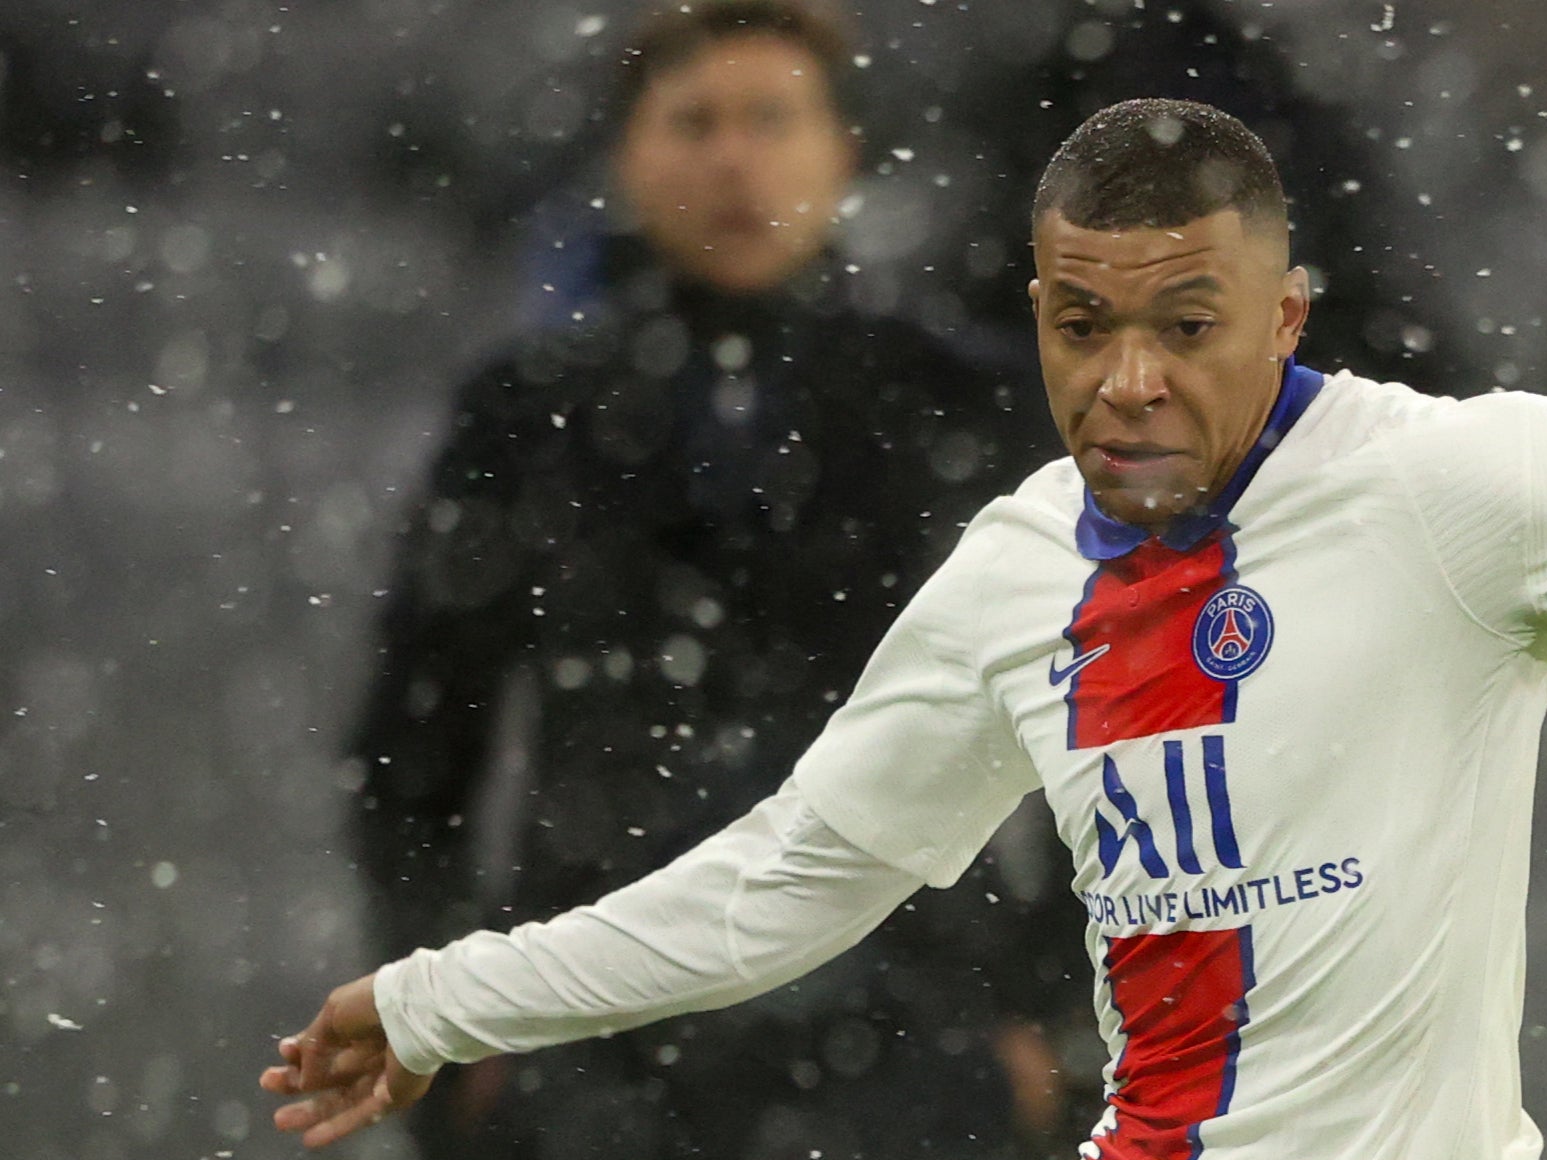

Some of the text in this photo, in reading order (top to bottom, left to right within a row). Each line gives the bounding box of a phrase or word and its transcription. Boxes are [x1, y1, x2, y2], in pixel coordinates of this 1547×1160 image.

[1206, 593, 1256, 618] PARIS
[1123, 892, 1178, 925] LIVE
[1184, 857, 1363, 919] LIMITLESS
